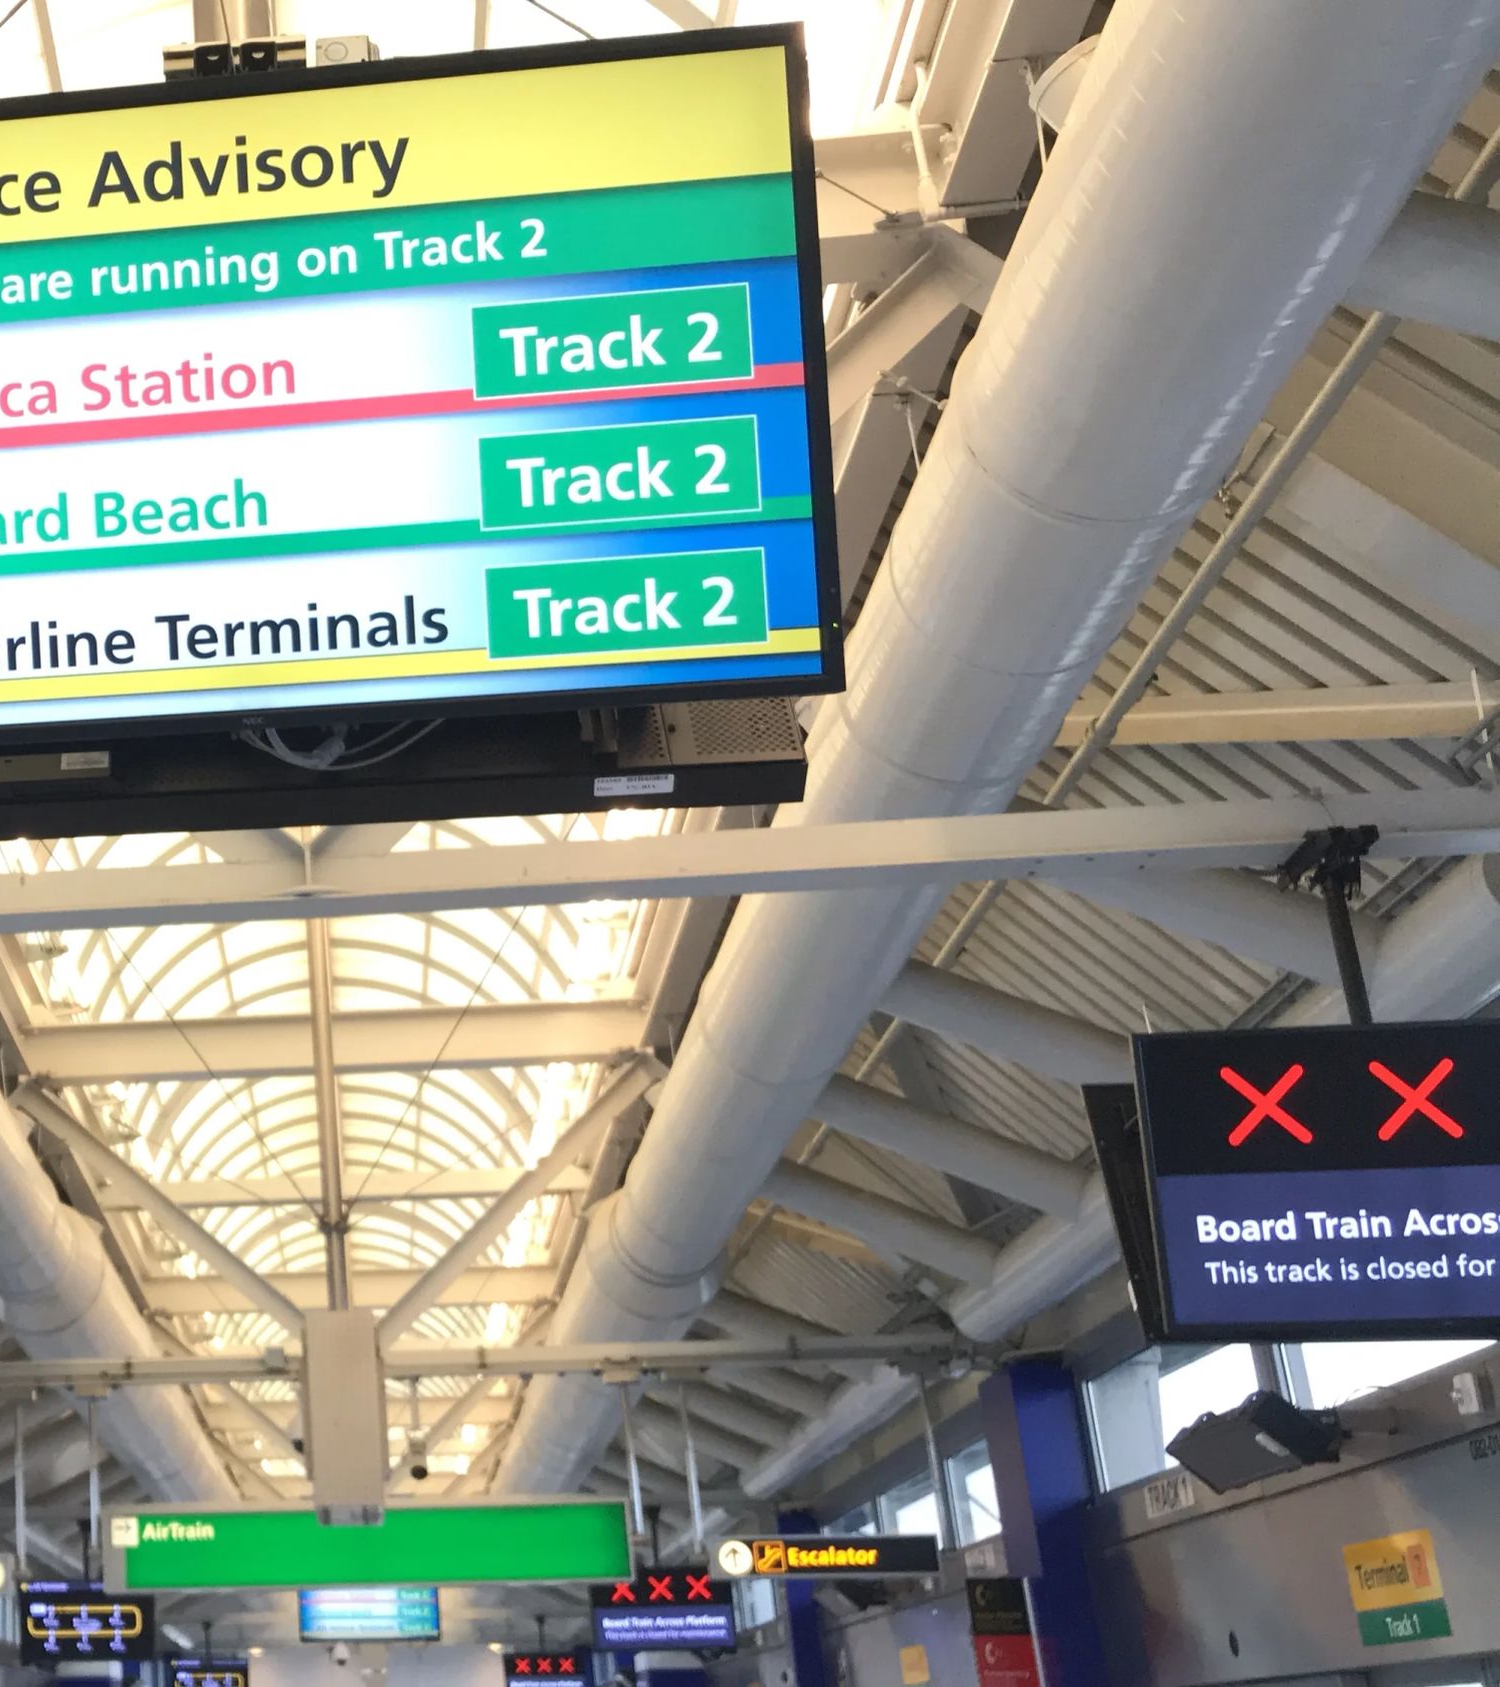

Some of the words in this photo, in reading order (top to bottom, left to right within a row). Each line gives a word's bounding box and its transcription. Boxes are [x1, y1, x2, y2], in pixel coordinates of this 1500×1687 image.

[87, 136, 410, 208] Advisory
[1, 267, 74, 305] are
[91, 246, 280, 296] running
[297, 241, 357, 278] on
[374, 220, 504, 271] Track
[521, 218, 548, 259] 2
[500, 314, 666, 378] Track
[687, 312, 723, 363] 2
[81, 352, 296, 412] Station
[506, 446, 674, 508] Track
[693, 444, 730, 495] 2
[94, 478, 268, 539] Beach
[154, 595, 449, 661] Terminals
[512, 578, 681, 639] Track
[701, 576, 738, 627] 2
[1196, 1210, 1297, 1243] Board
[1305, 1209, 1392, 1240] Train
[1403, 1208, 1500, 1237] Acros
[1204, 1260, 1259, 1285] This
[1265, 1257, 1332, 1283] track
[1339, 1257, 1359, 1281] is
[1366, 1254, 1449, 1280] closed
[1455, 1253, 1496, 1278] for
[142, 1521, 216, 1542] AirTrain
[787, 1545, 879, 1567] Escalator
[1354, 1555, 1410, 1590] Terminal
[1385, 1613, 1415, 1638] Track
